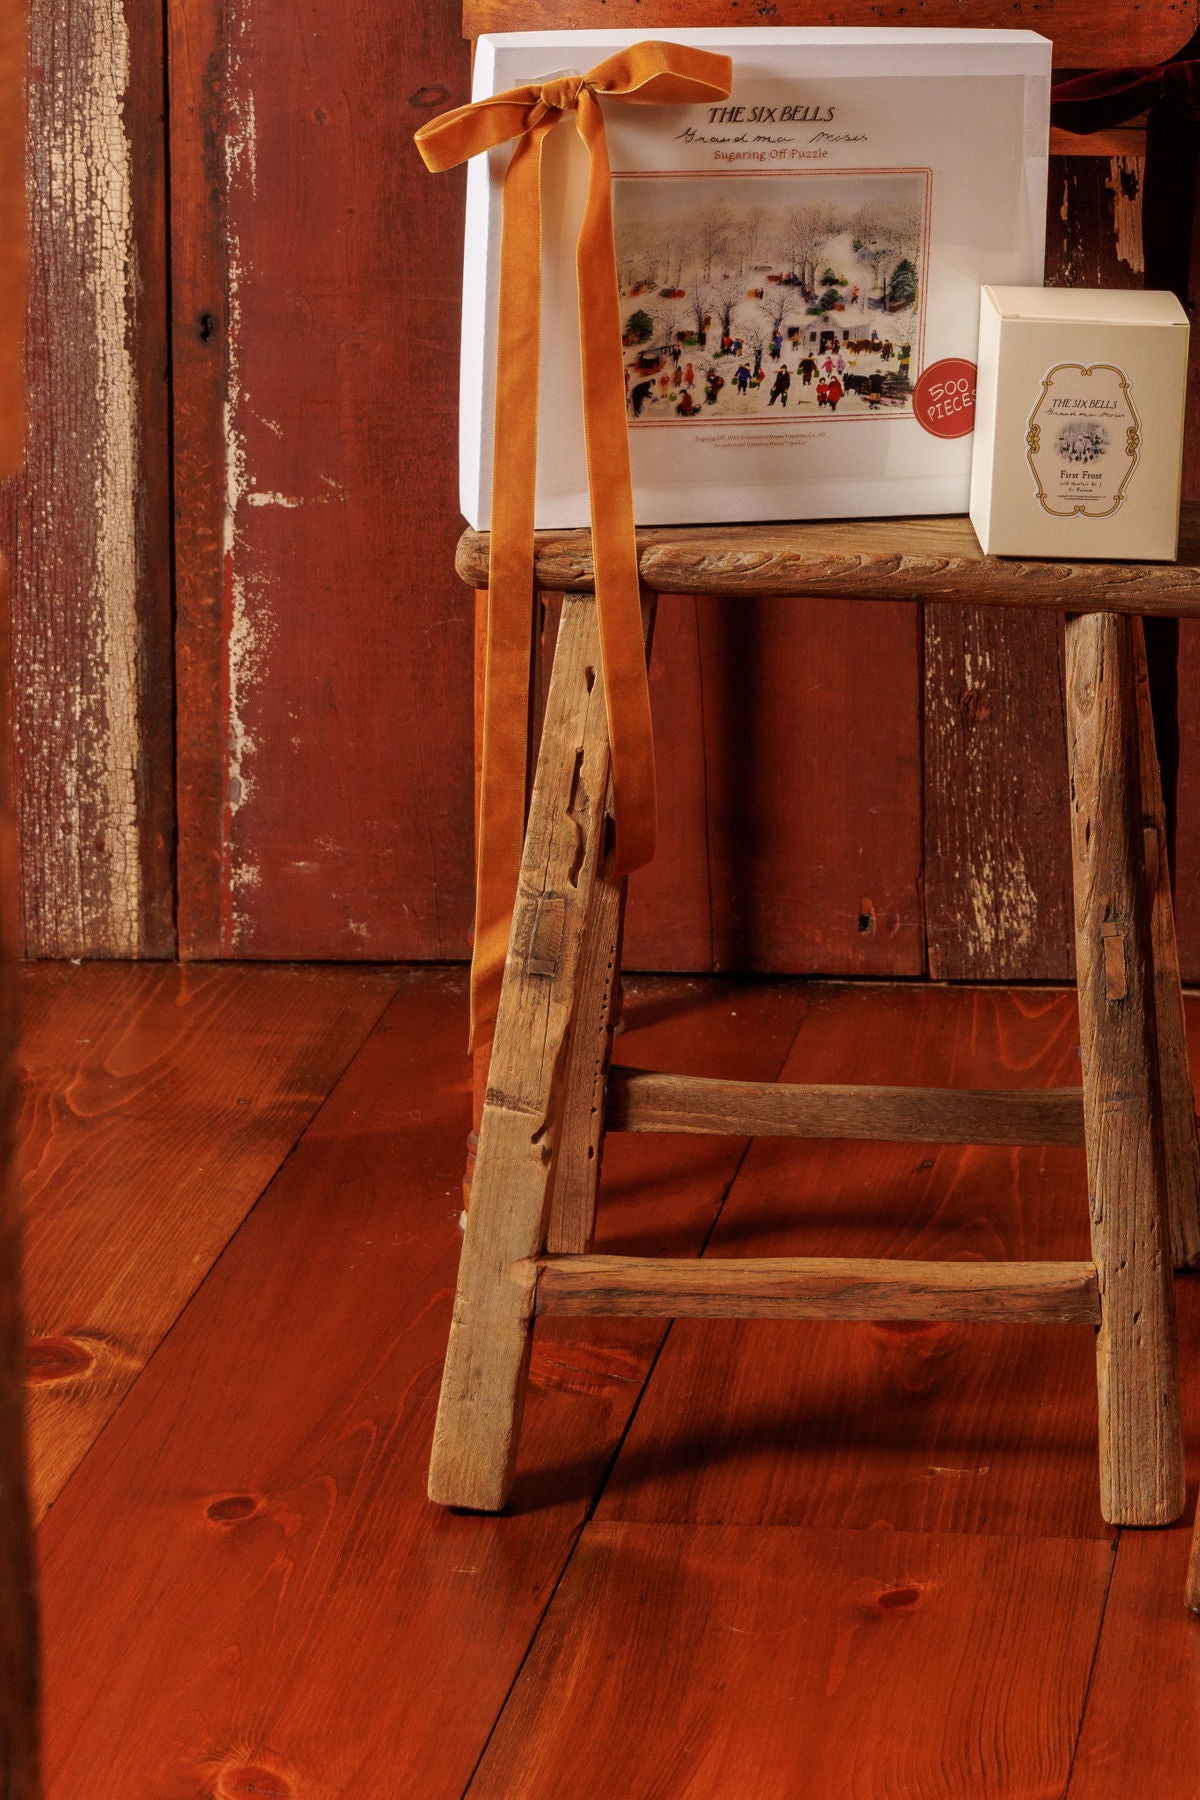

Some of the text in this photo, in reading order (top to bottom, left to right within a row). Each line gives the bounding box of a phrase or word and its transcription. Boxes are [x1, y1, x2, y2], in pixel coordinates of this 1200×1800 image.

[709, 105, 836, 123] THE SIX BELLS
[714, 148, 829, 162] Sugaring Off Puzzle
[928, 378, 969, 402] 500
[1052, 398, 1118, 409] THE SIX BELLS
[1060, 469, 1103, 479] First Frost
